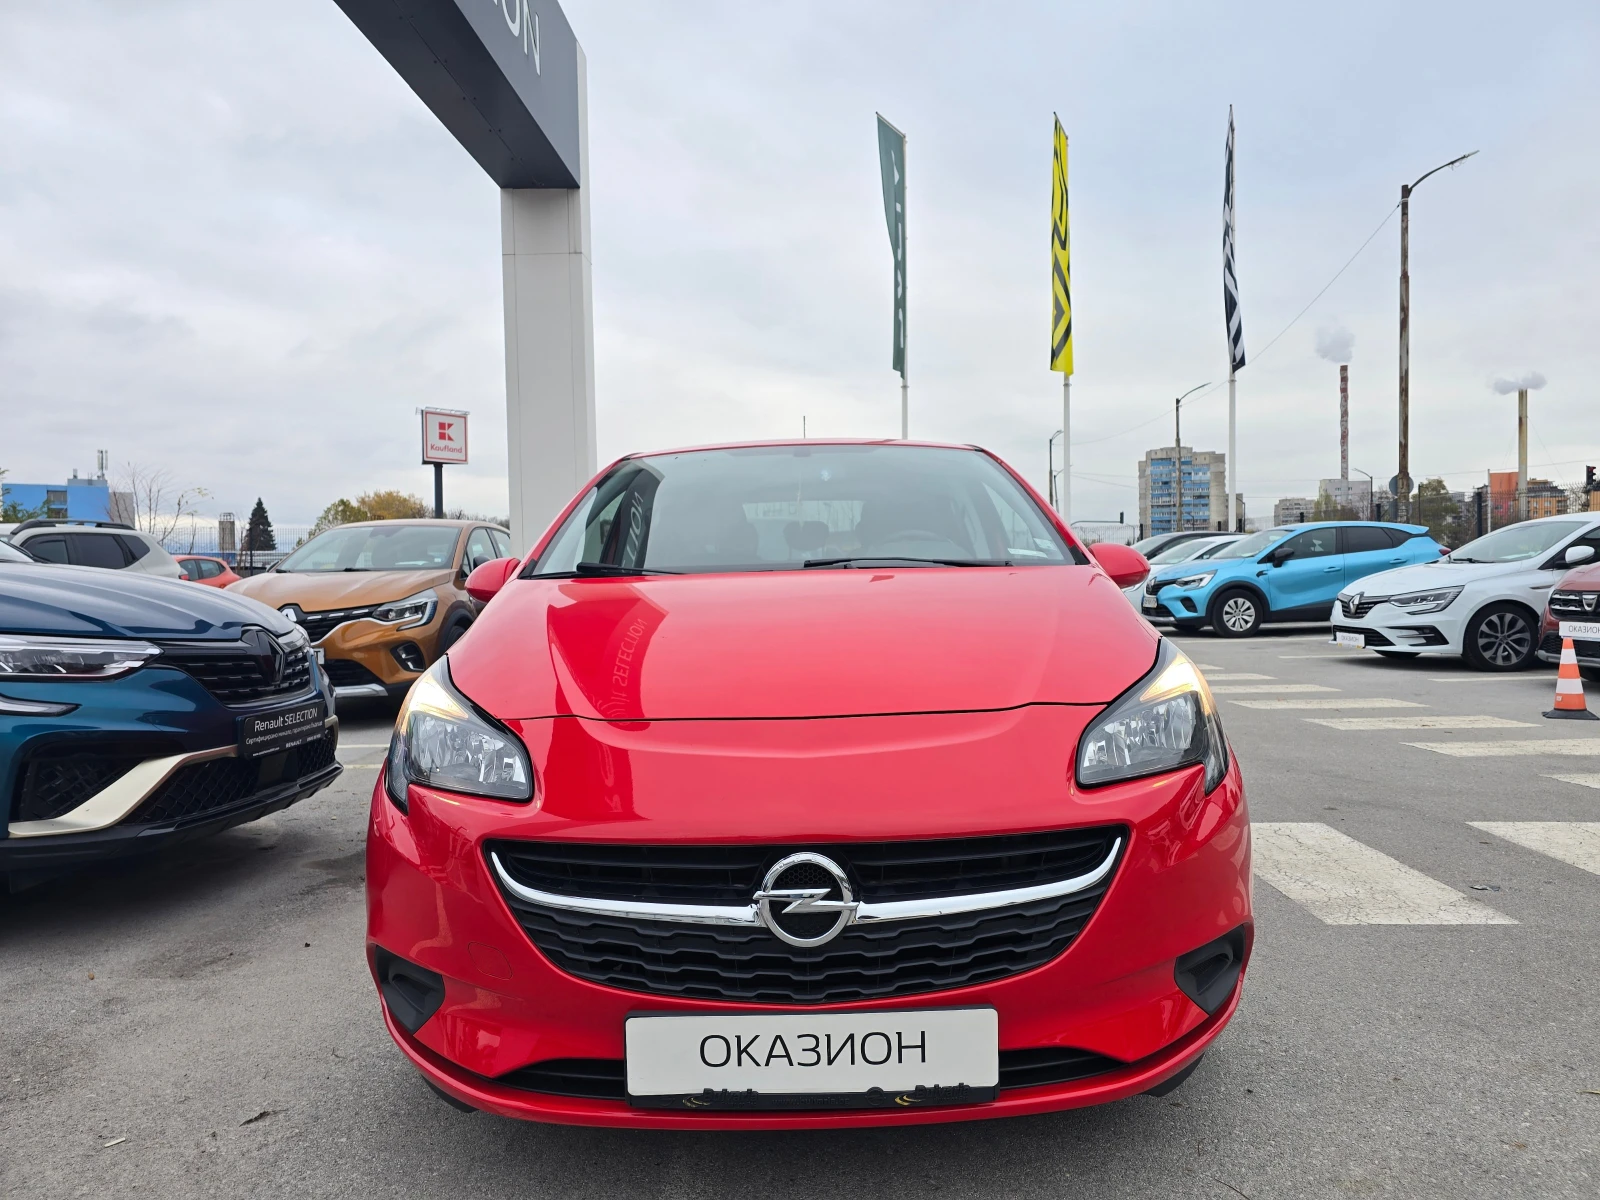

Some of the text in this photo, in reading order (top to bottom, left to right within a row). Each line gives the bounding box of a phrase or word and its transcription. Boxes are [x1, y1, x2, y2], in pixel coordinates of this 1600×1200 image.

[430, 443, 463, 454] Kaufland
[254, 715, 284, 732] Renault
[284, 707, 318, 726] SELECTION
[285, 739, 302, 749] RENAULT
[700, 1030, 926, 1068] ОКАЗИОН
